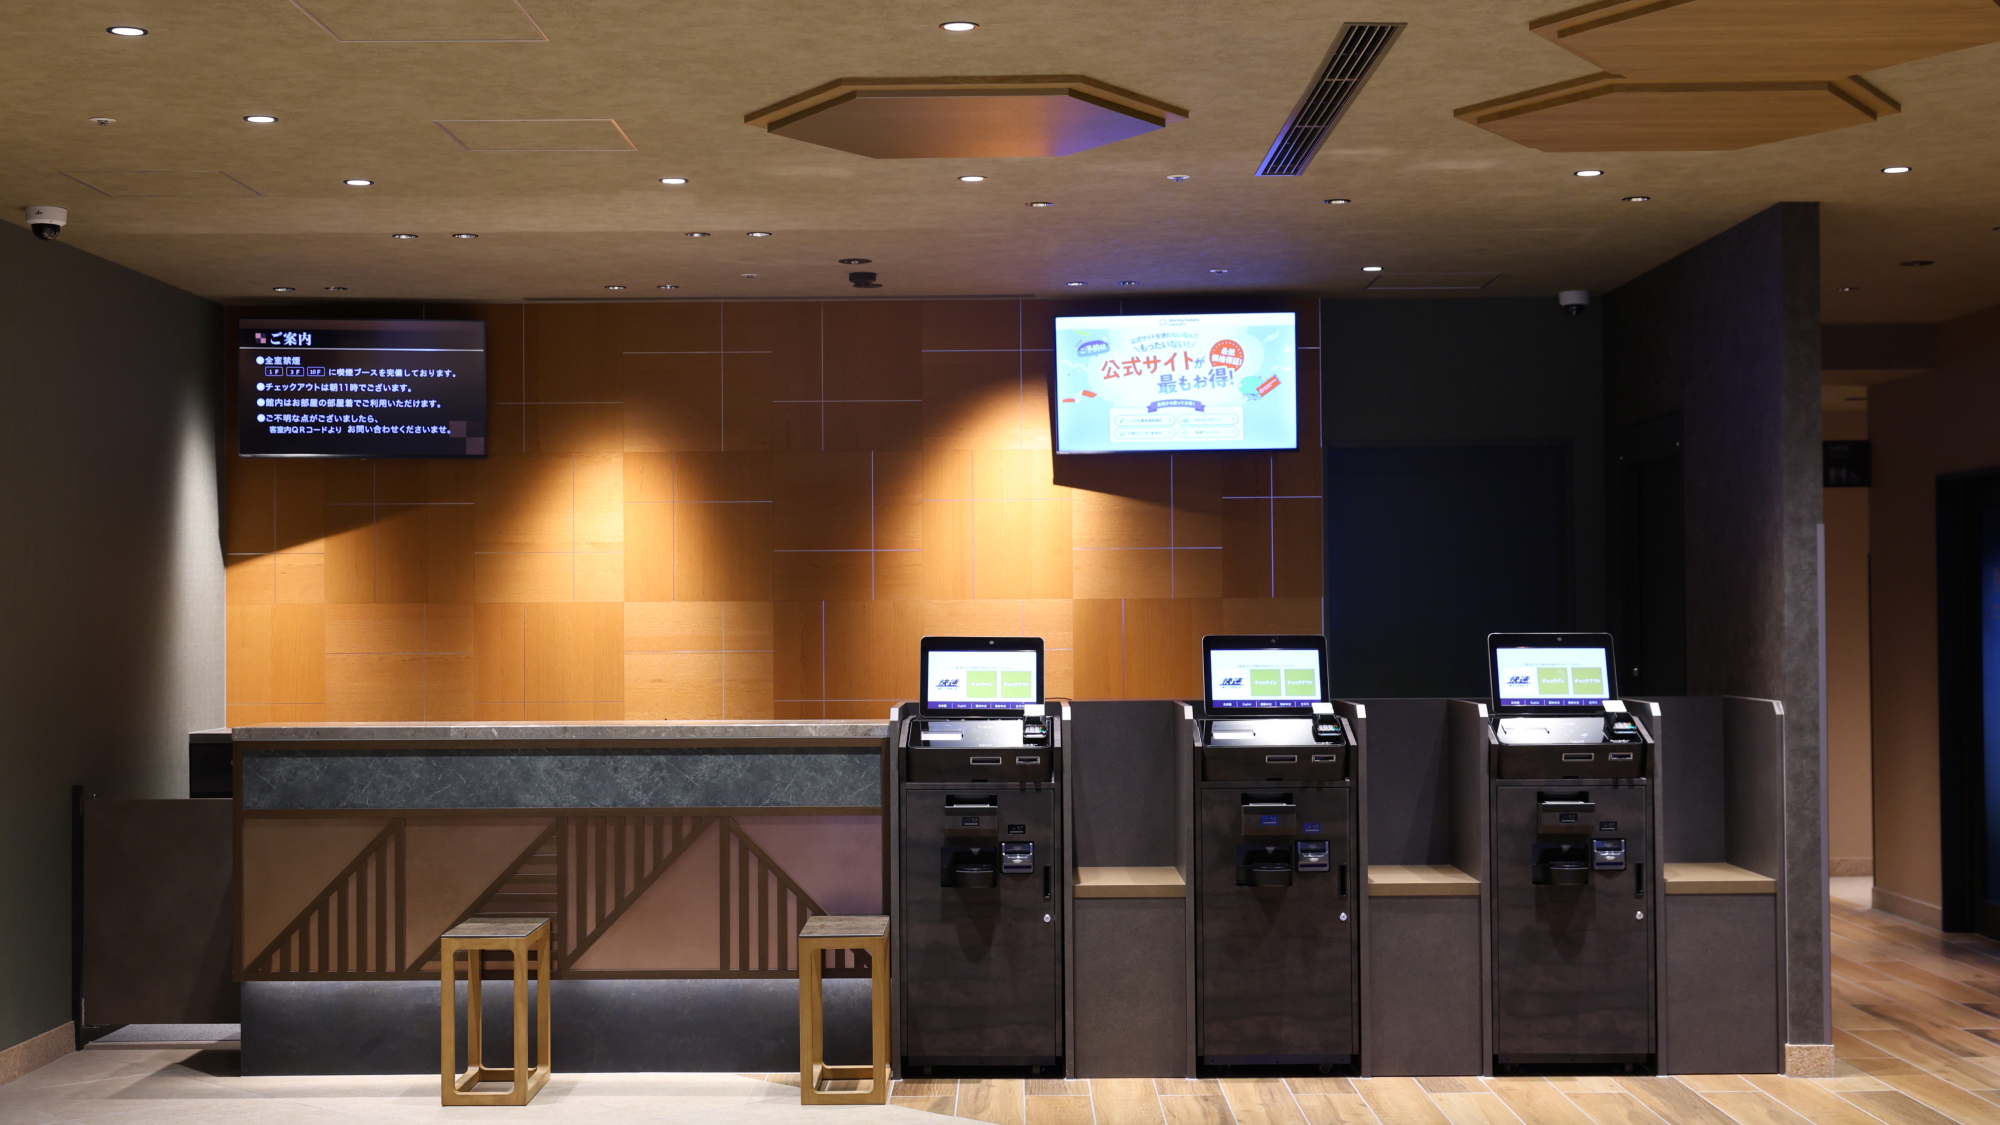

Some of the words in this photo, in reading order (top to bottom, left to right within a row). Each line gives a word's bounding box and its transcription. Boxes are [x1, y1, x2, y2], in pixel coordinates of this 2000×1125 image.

[270, 331, 312, 346] ご案内
[1079, 343, 1107, 355] ご予約は
[265, 356, 301, 366] 全室禁煙
[1101, 351, 1206, 381] 公式サイトが
[329, 368, 457, 378] に喫煙ブースを完備しております。
[1157, 367, 1235, 395] 最もお得!
[265, 382, 412, 393] チェックアウトは朝11時でございます。
[265, 398, 442, 409] 館内はお部屋の部屋着でご利用いただけます。
[266, 413, 379, 423] ご不明な点がございましたら、
[348, 425, 452, 435] お問い合わせくださいませ。
